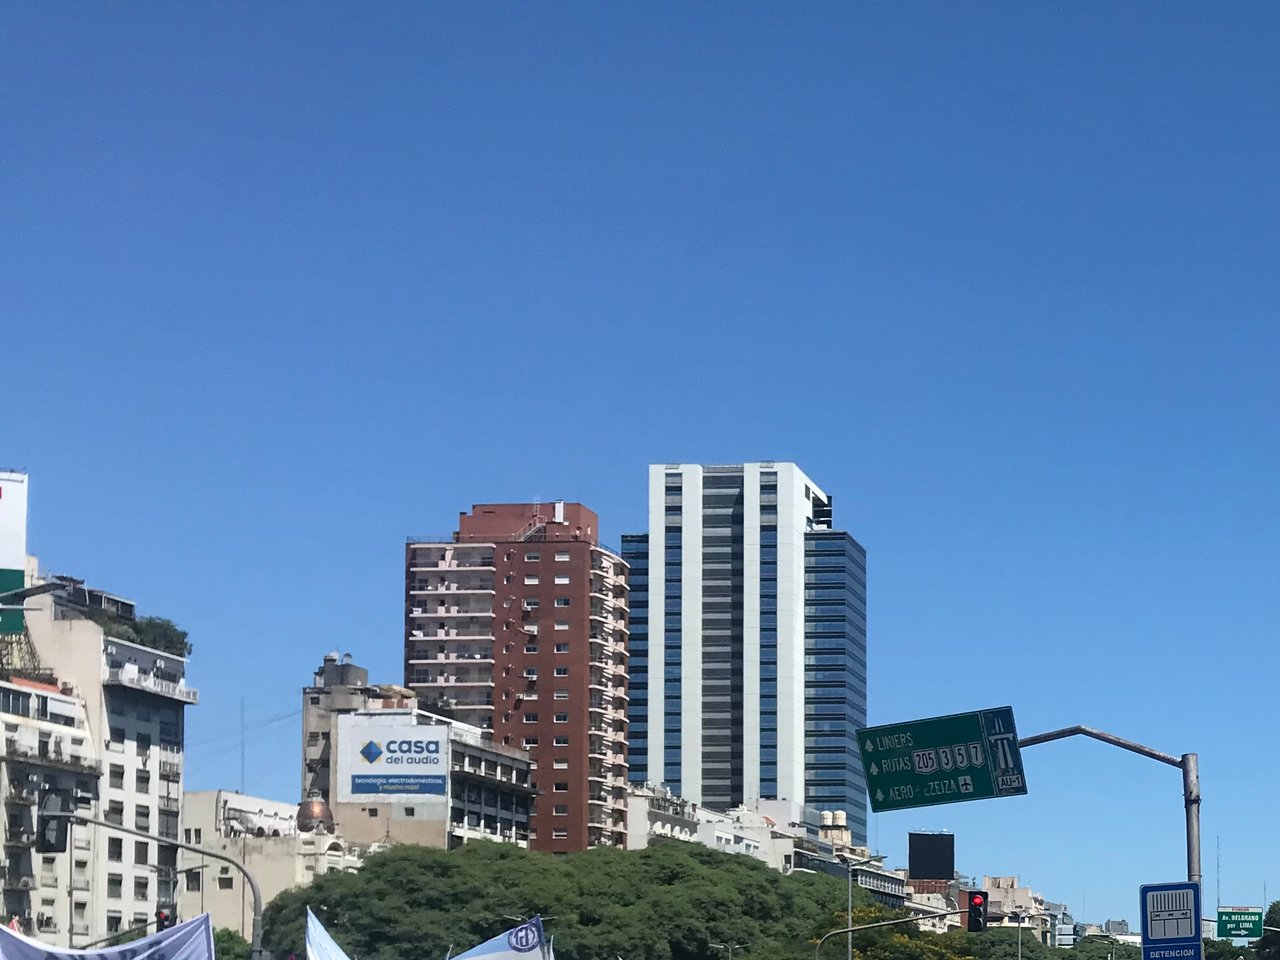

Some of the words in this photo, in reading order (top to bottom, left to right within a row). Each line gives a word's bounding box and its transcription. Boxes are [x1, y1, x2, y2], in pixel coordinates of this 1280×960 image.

[386, 740, 440, 754] casa
[876, 732, 914, 751] LINIERS
[386, 756, 403, 765] del
[406, 756, 439, 765] audio
[882, 757, 911, 773] RUTAS
[915, 753, 935, 769] 205
[942, 750, 950, 766] 3
[957, 748, 965, 763] 5
[971, 746, 978, 761] 7
[923, 780, 958, 797] ZEIZA
[1000, 777, 1022, 788] AU-1
[1150, 949, 1195, 959] DETENCION
